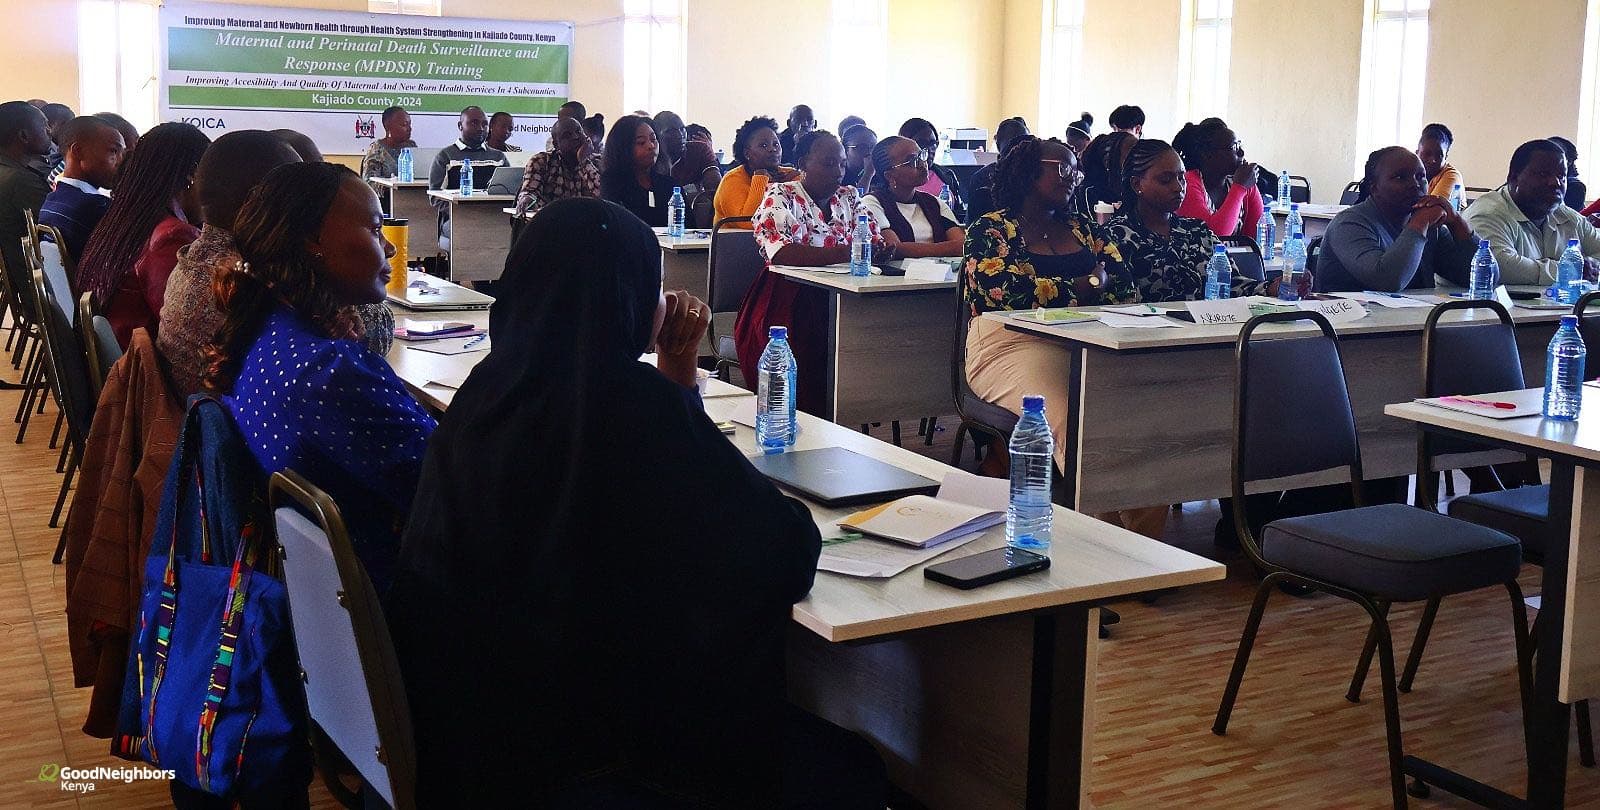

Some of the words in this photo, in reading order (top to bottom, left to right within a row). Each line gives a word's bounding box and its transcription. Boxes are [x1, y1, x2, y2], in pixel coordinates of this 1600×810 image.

[184, 15, 226, 27] Improving
[227, 18, 262, 29] Maternal
[263, 19, 278, 29] and
[279, 20, 313, 30] Newborn
[314, 22, 339, 32] Health
[340, 23, 370, 34] through
[370, 25, 394, 35] Health
[395, 26, 422, 36] System
[422, 28, 473, 39] Strengthening
[482, 31, 508, 40] Kajiado
[509, 31, 534, 42] County,
[535, 33, 556, 43] Kenya
[215, 32, 284, 49] Maternal
[287, 36, 314, 50] and
[318, 37, 383, 53] Perinatal
[386, 40, 427, 55] Death
[430, 42, 512, 58] Surveillance
[515, 47, 540, 59] and
[284, 56, 351, 74] Response
[354, 59, 422, 77] (MPDSR)
[427, 62, 484, 80] Training
[185, 75, 230, 87] Improving
[232, 77, 279, 89] Accesibility
[280, 79, 297, 88] And
[299, 79, 329, 90] Quality
[330, 80, 343, 90] Of
[343, 80, 380, 90] Maternal
[380, 82, 397, 91] And
[399, 83, 416, 91] New
[417, 83, 438, 92] Born
[438, 84, 464, 93] Health
[465, 85, 496, 94] Services
[497, 85, 506, 94] In
[507, 86, 512, 94] 4
[513, 87, 556, 96] Subcounties
[312, 94, 355, 106] Kajiado
[357, 95, 394, 108] County
[396, 96, 422, 107] 2024
